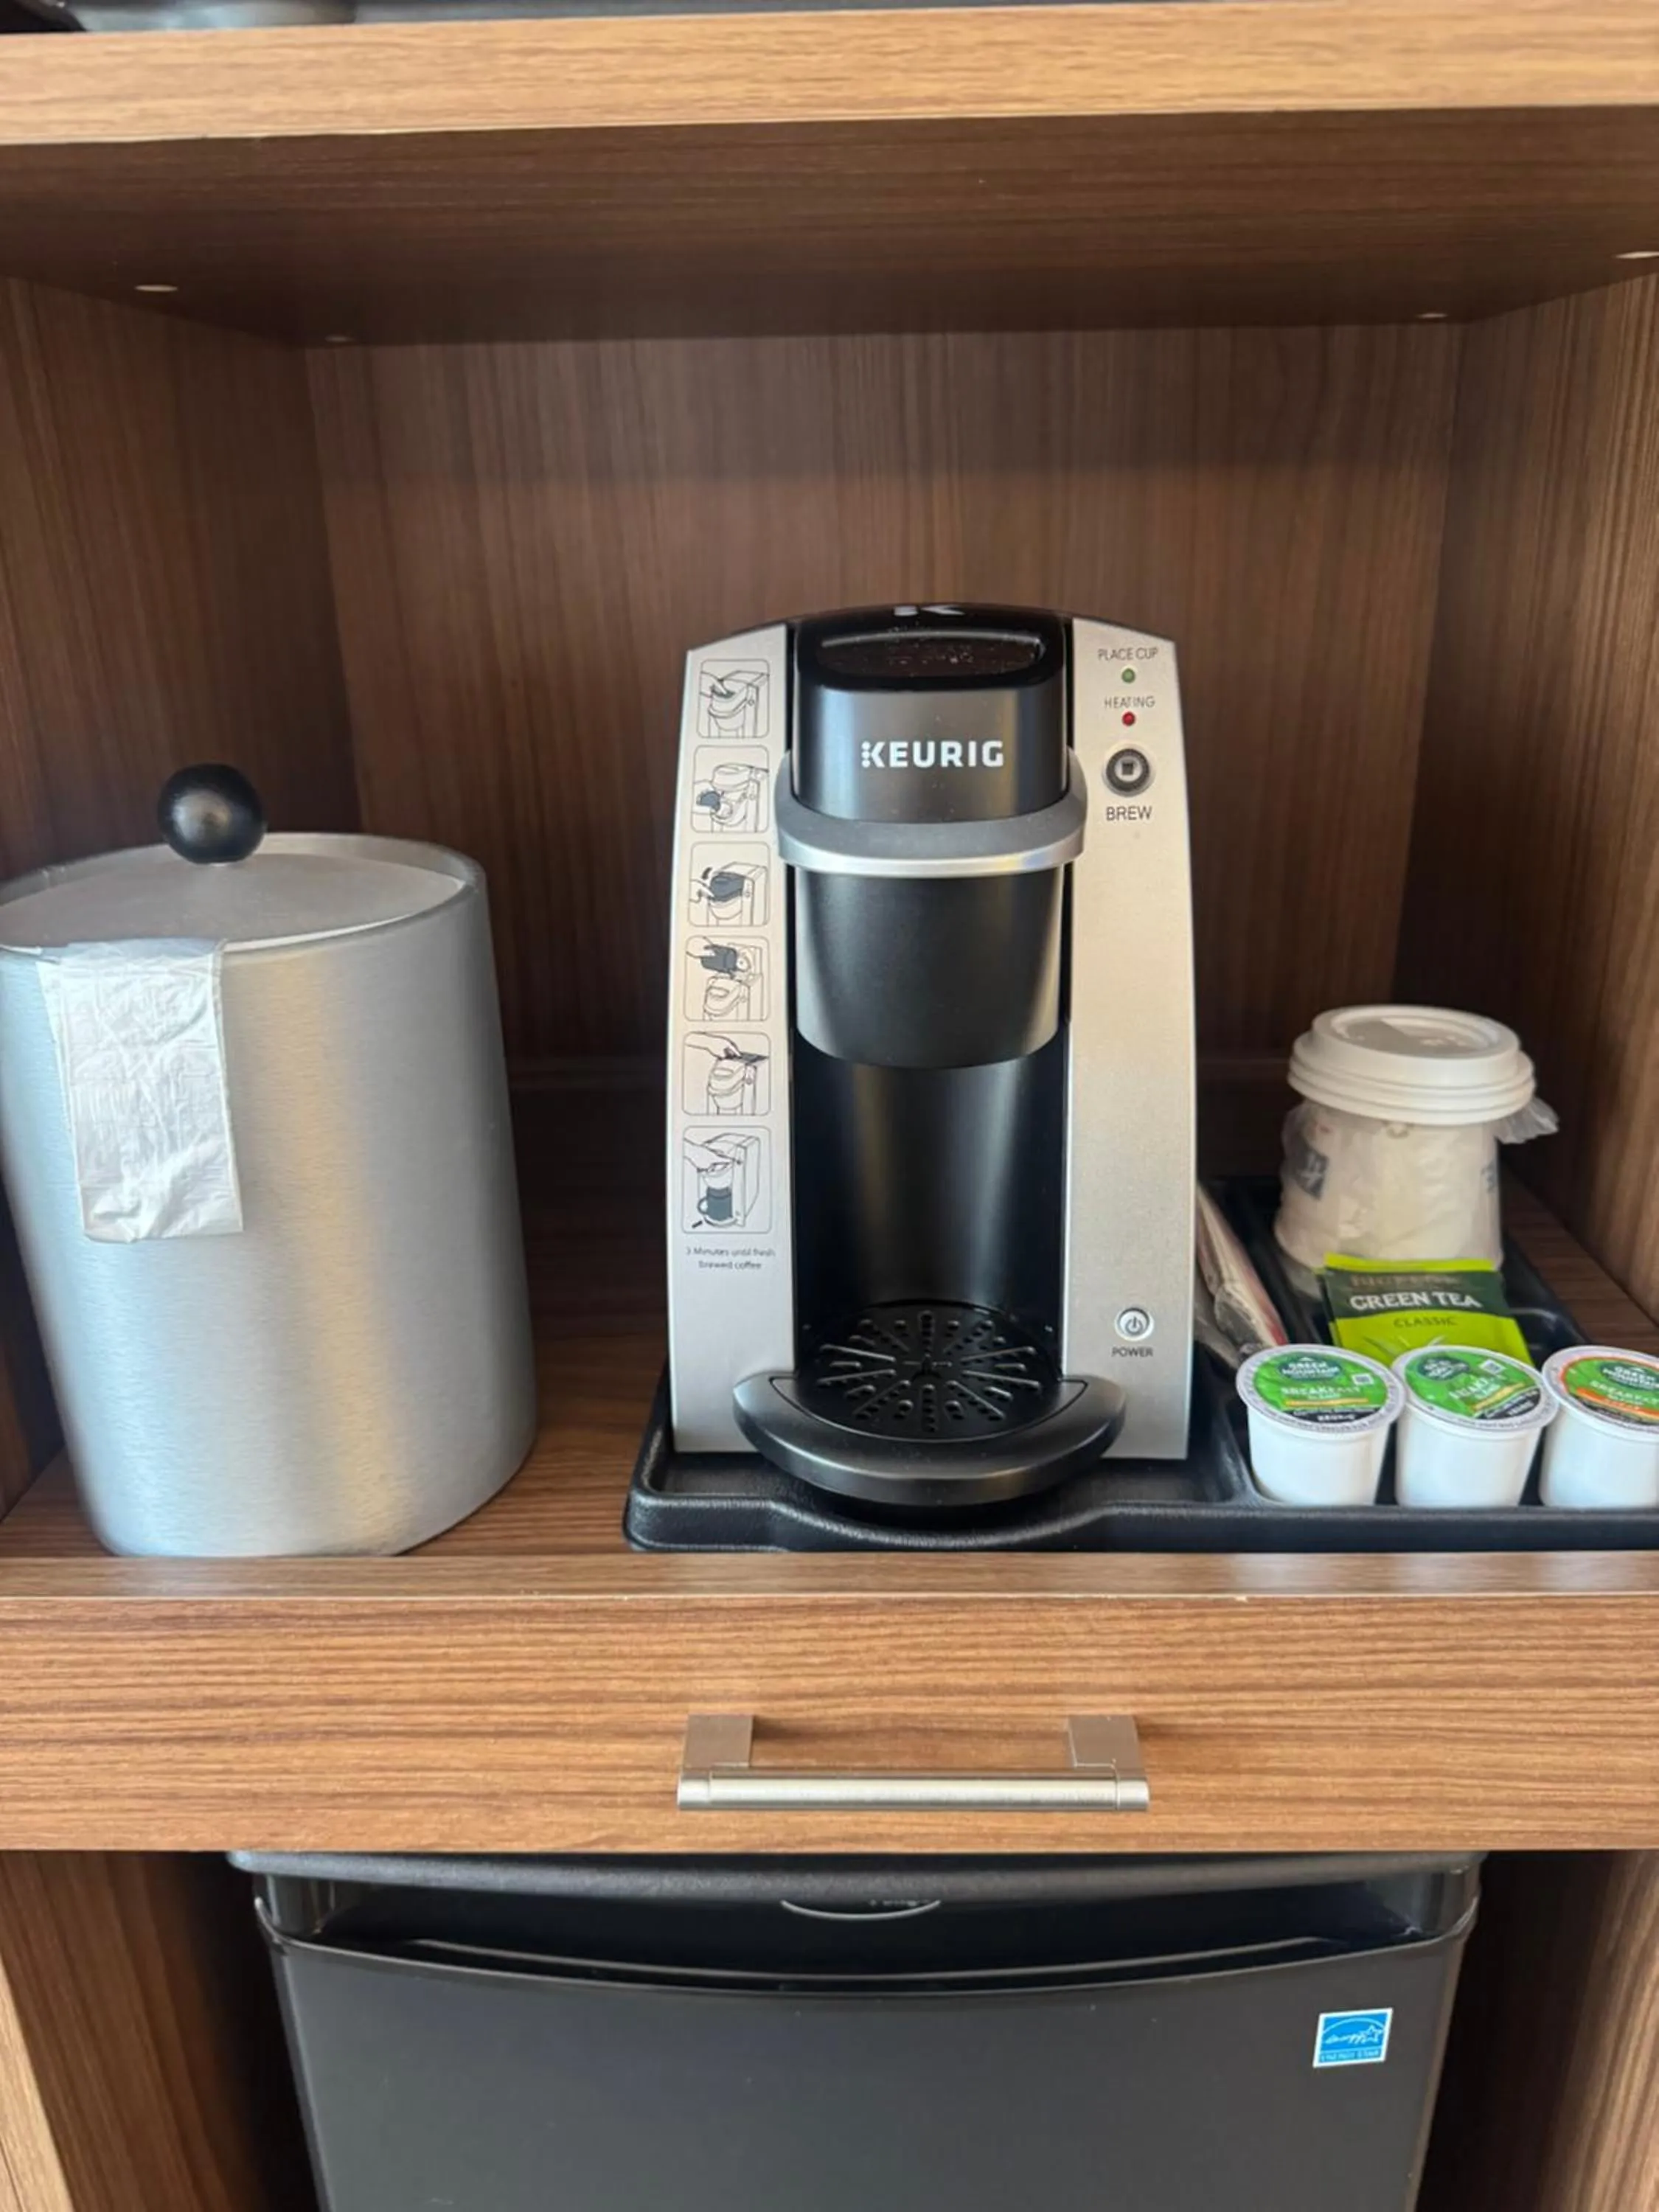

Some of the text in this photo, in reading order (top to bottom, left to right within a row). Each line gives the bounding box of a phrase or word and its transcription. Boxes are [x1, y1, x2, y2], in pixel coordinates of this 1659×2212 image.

[1098, 647, 1158, 661] PLACE CUP
[1105, 696, 1155, 708] HEATING
[861, 740, 1004, 768] KEURIG
[1106, 806, 1152, 821] BREW
[1350, 1292, 1484, 1310] GREEN TEA
[1393, 1316, 1457, 1328] CLASSIC
[1111, 1346, 1154, 1357] POWER
